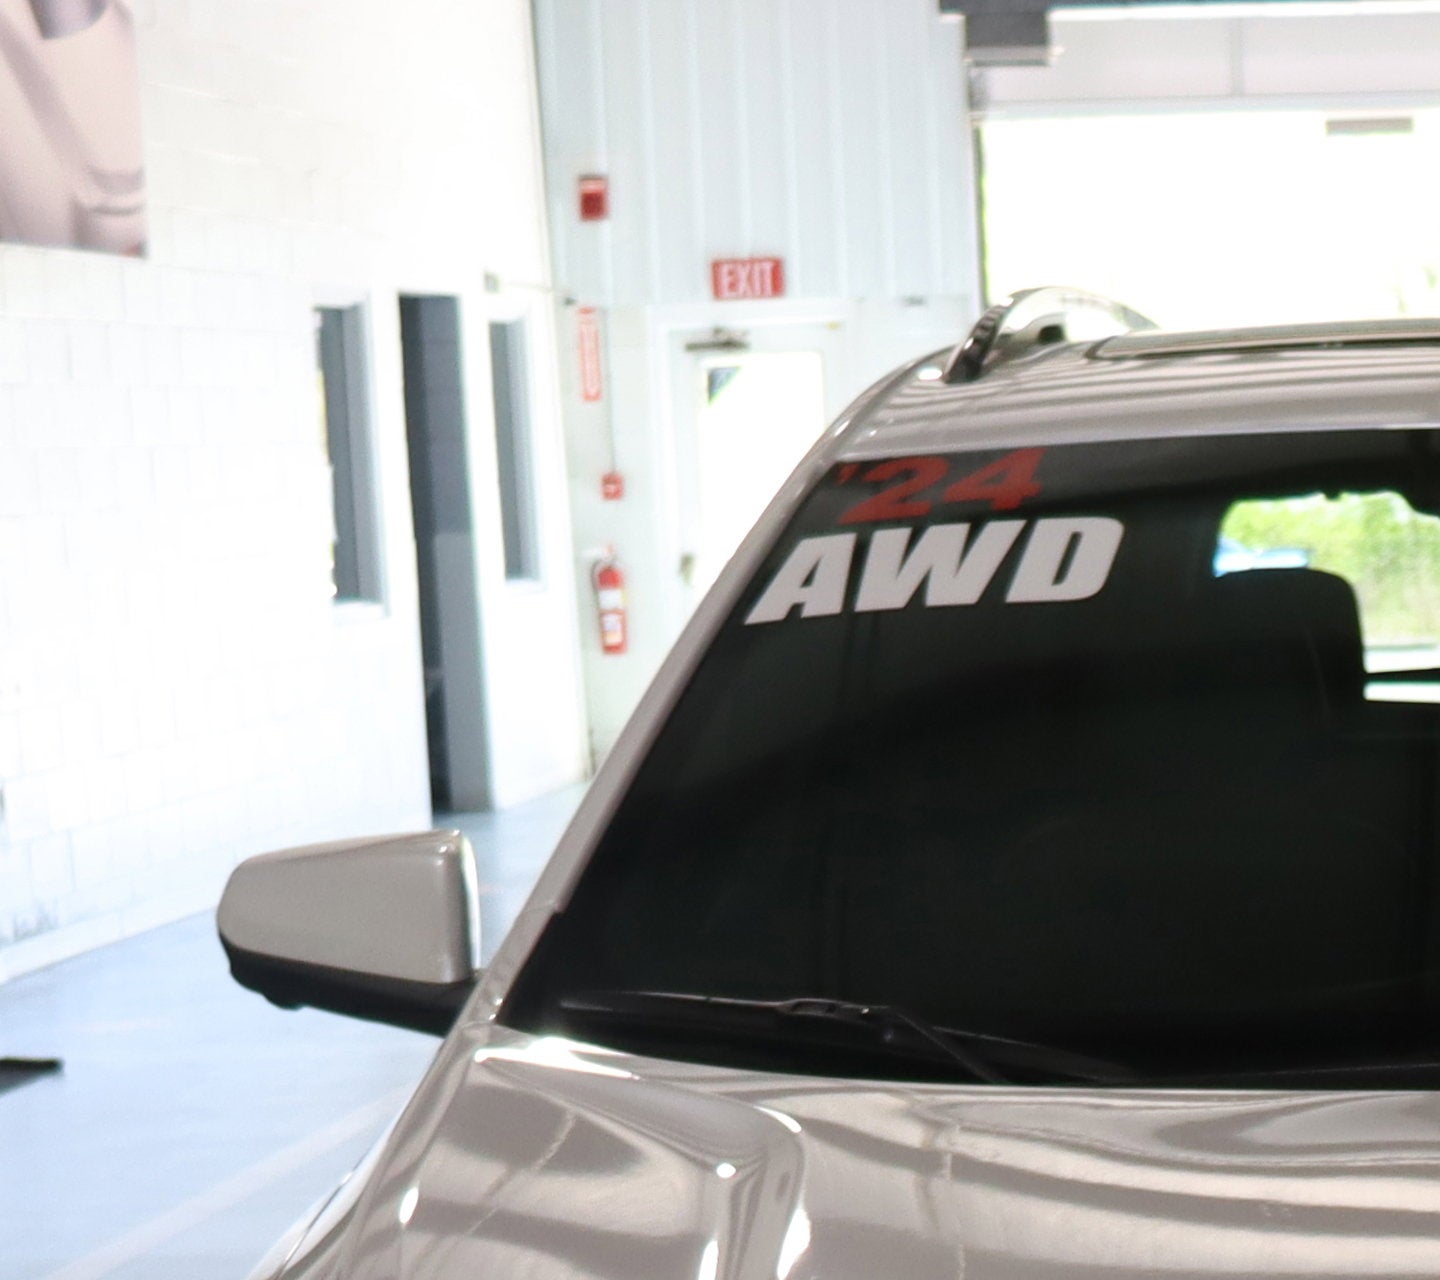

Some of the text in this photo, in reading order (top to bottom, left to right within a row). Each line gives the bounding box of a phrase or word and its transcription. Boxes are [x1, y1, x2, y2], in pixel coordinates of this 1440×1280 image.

[719, 260, 775, 298] EXIT
[836, 447, 1048, 526] '24
[744, 516, 1125, 626] AWD
